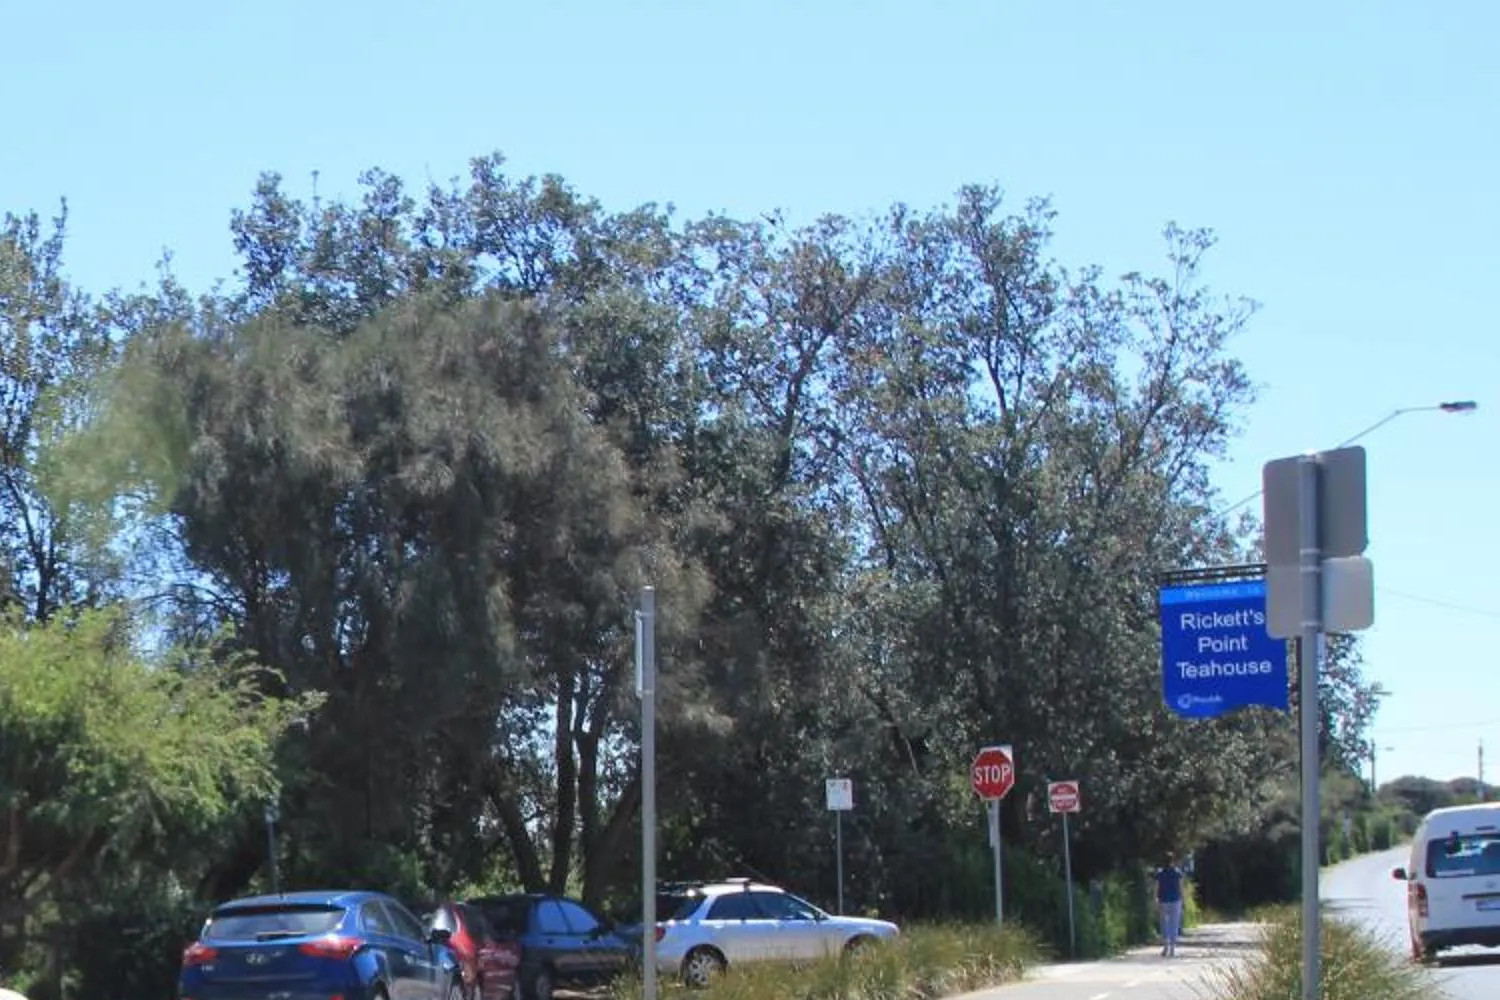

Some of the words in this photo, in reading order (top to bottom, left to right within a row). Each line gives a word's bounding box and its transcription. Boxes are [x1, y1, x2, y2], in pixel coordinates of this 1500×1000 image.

[1180, 610, 1264, 631] Rickett's
[1198, 634, 1248, 653] Point
[1176, 660, 1272, 679] Teahouse
[975, 763, 1011, 785] STOP
